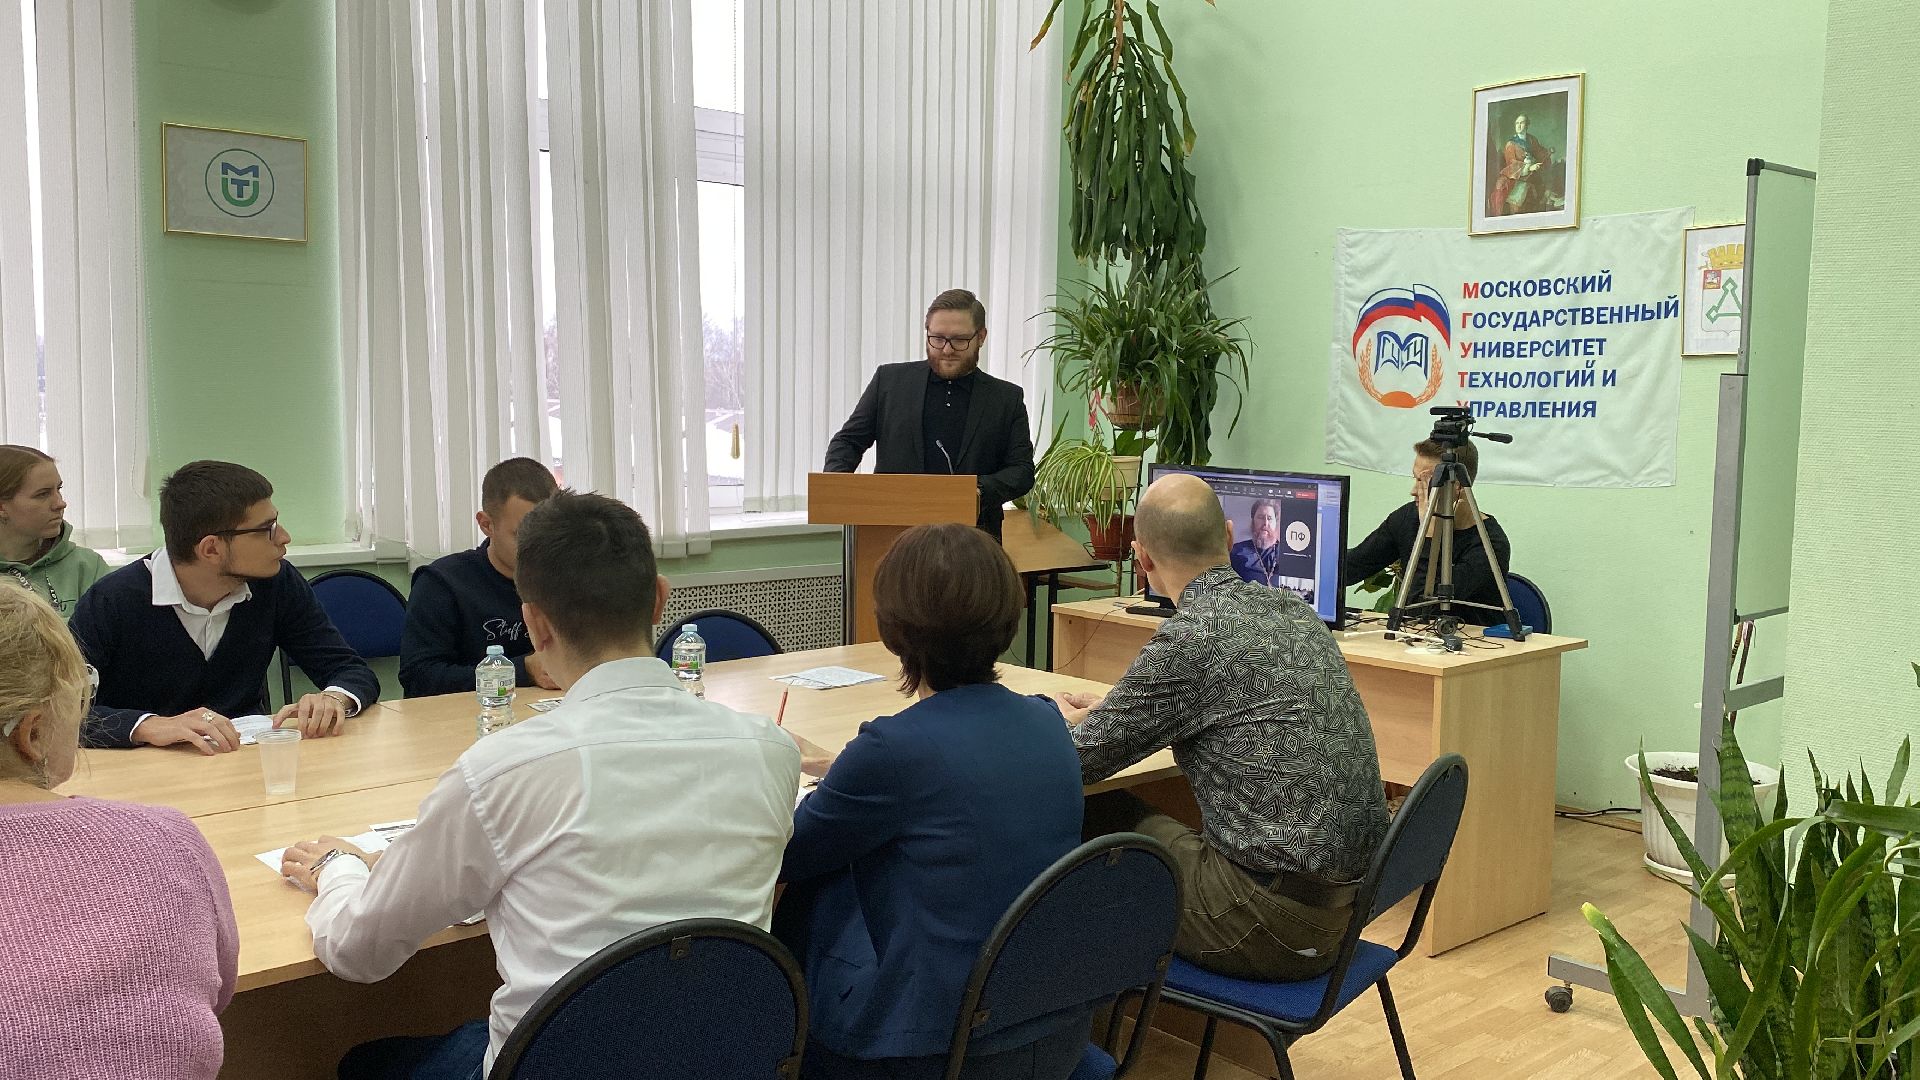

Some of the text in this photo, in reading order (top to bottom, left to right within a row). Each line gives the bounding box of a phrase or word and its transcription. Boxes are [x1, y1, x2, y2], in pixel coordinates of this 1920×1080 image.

[1462, 269, 1612, 299] МОСКОВСКИЙ
[1461, 294, 1680, 332] ГОСУДАРСТВЕННЫЙ
[1459, 338, 1607, 359] УНИВЕРСИТЕТ
[1457, 360, 1617, 389] ТЕХНОЛОГИЙ И
[1290, 530, 1306, 542] ПФ
